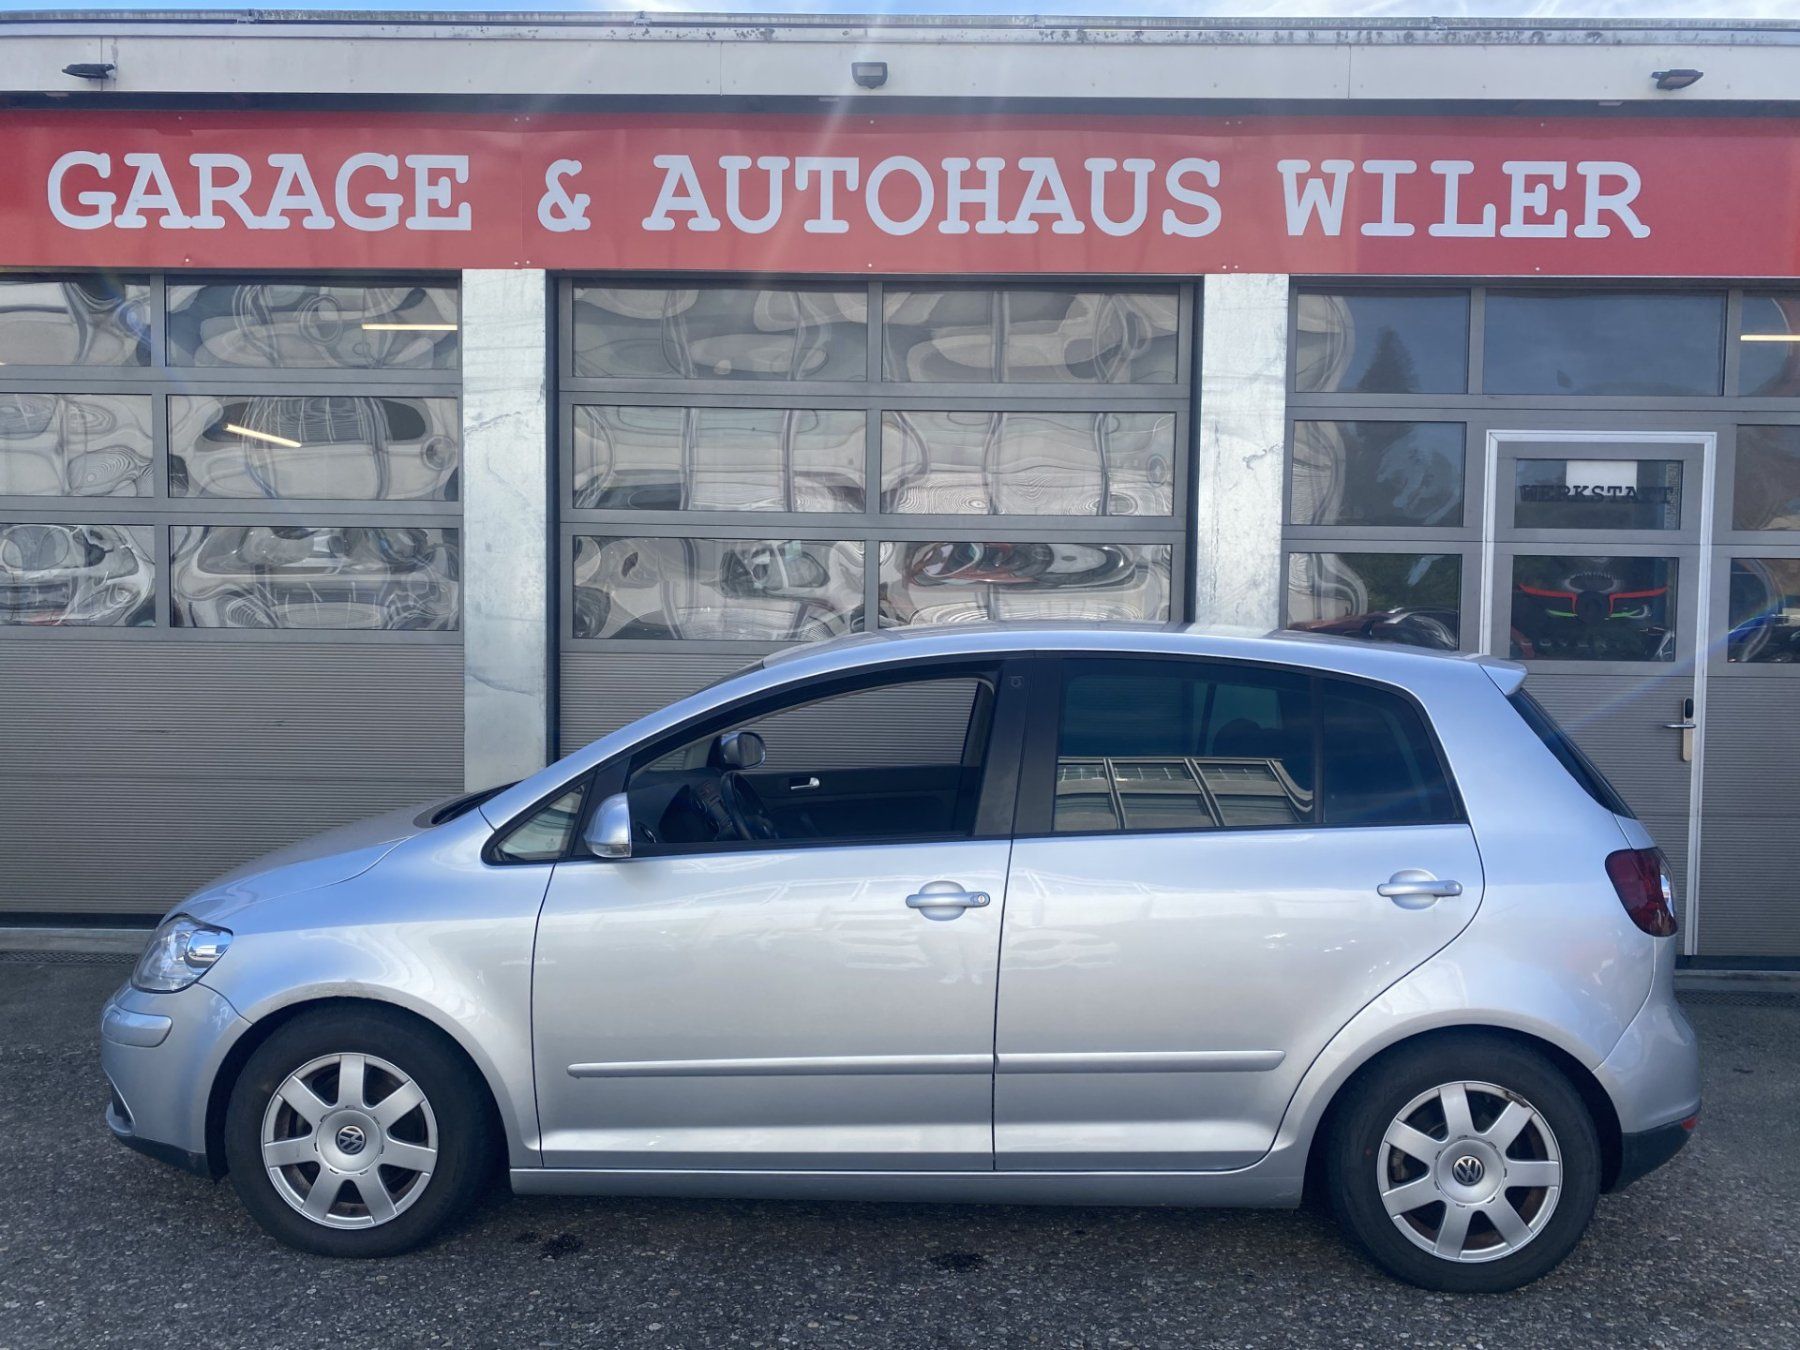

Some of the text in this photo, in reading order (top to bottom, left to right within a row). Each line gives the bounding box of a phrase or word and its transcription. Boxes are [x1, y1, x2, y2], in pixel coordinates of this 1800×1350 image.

[47, 150, 1652, 239] GARAGE & AUTOHAUS WILER
[1453, 1156, 1484, 1186] VW
